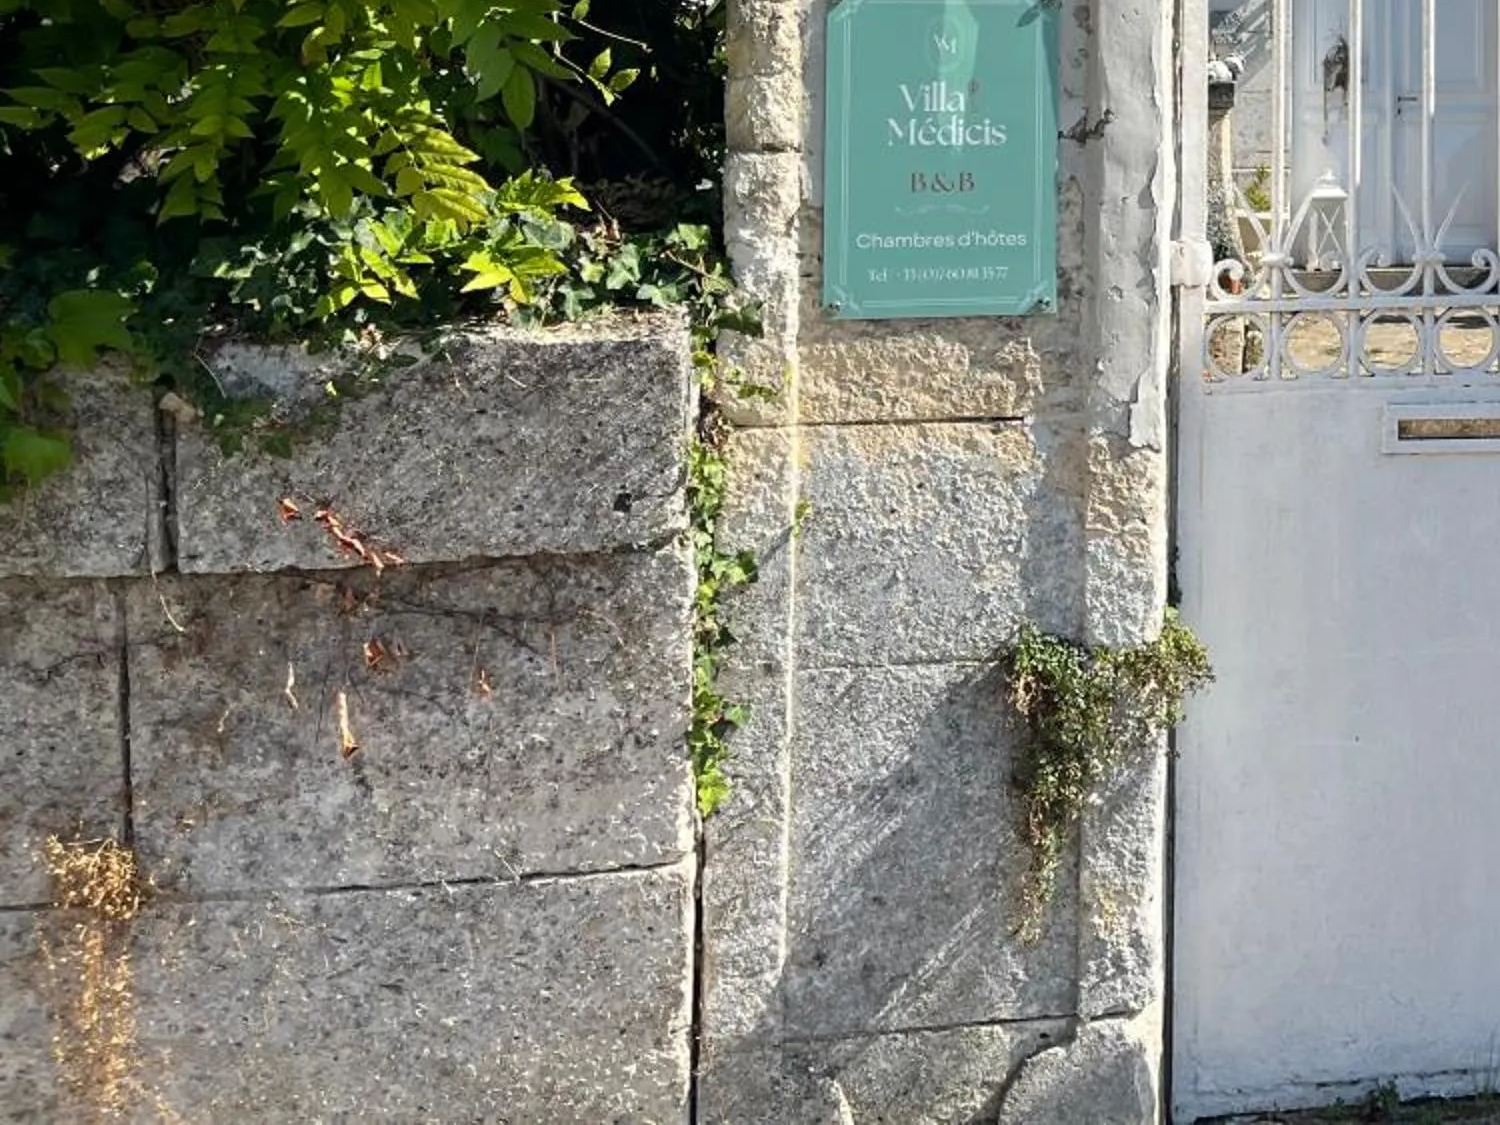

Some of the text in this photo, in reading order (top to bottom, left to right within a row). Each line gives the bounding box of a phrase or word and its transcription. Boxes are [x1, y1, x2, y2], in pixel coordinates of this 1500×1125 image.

[899, 80, 966, 113] Villa
[887, 114, 1008, 147] Médicis
[911, 172, 975, 193] B&B
[855, 229, 1028, 249] Chambres d'hôtes
